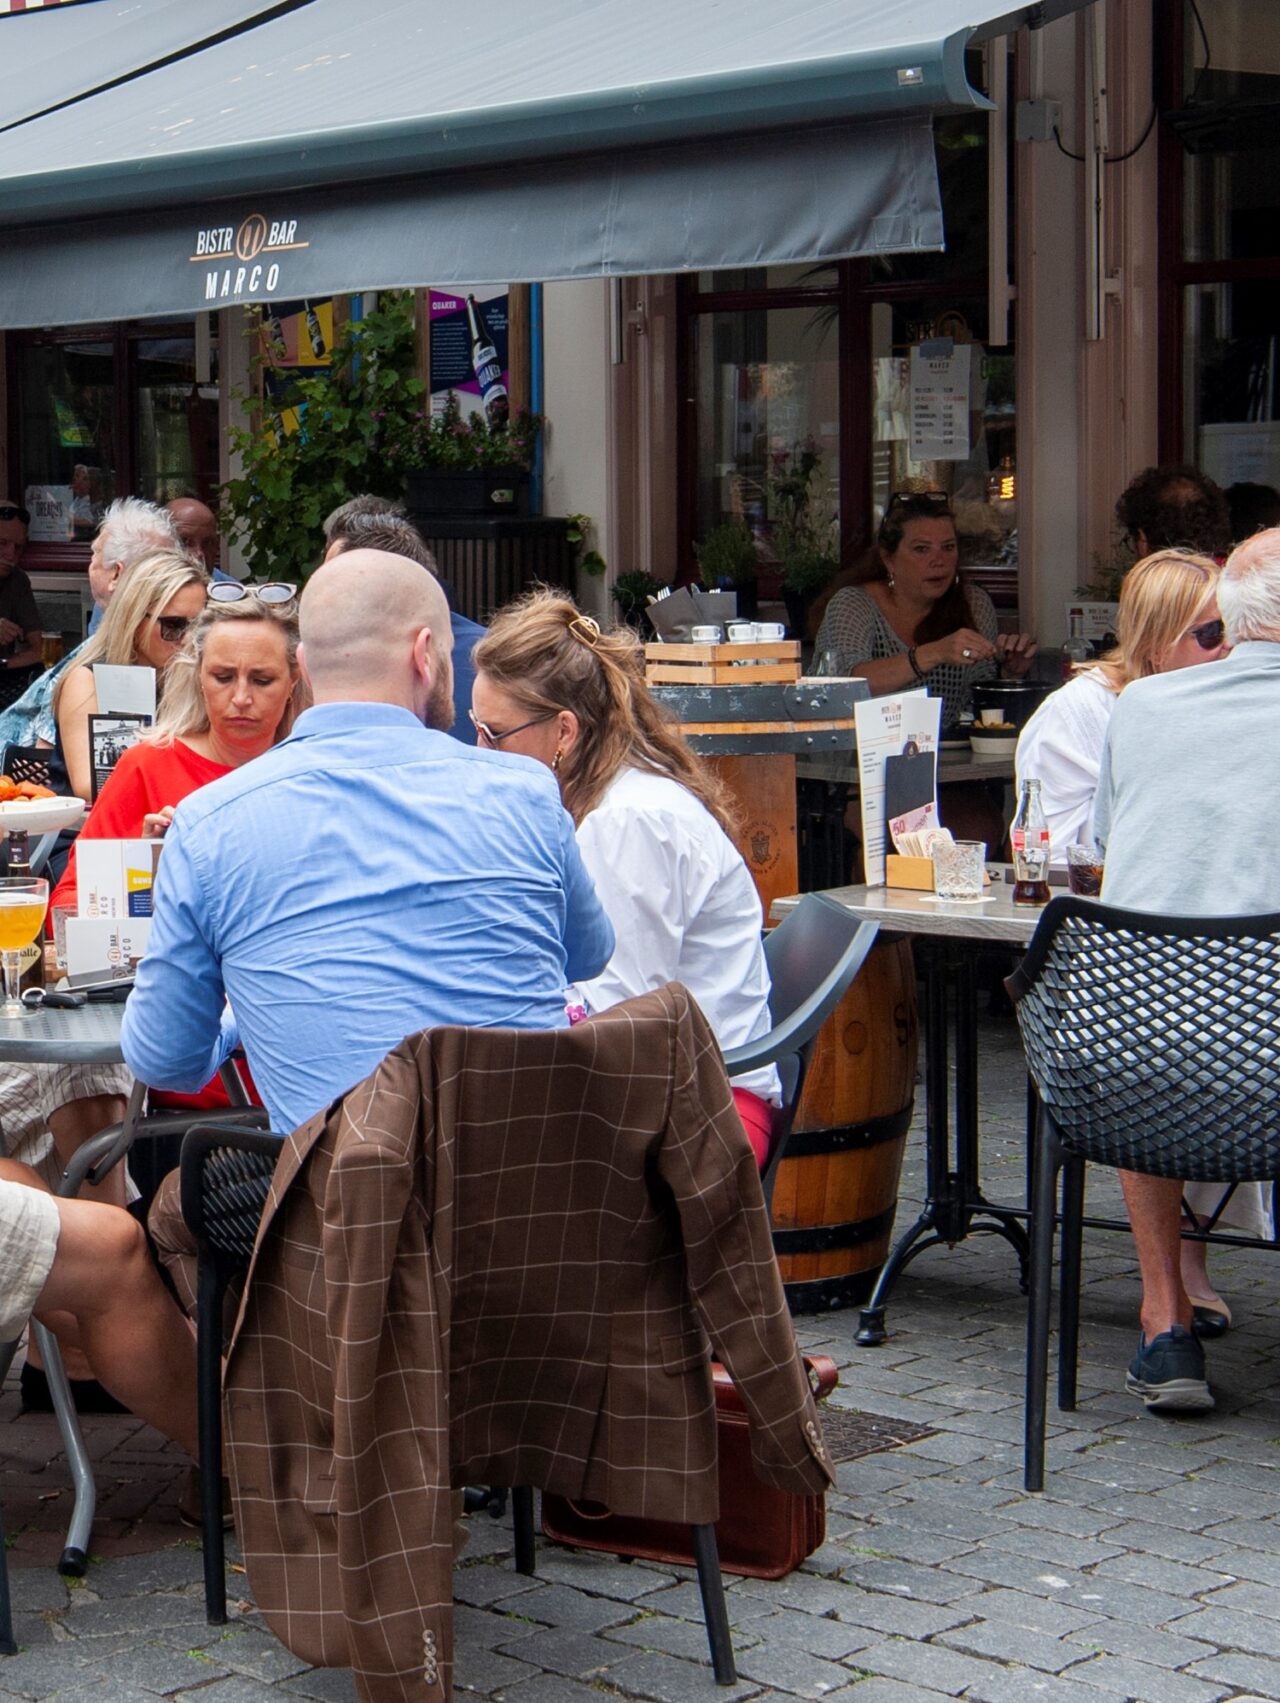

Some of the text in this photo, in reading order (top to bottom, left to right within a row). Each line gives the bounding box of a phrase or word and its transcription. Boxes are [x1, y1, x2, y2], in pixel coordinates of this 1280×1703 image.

[267, 220, 298, 246] BAR
[205, 263, 280, 300] MARCO
[432, 301, 456, 310] QUAKER
